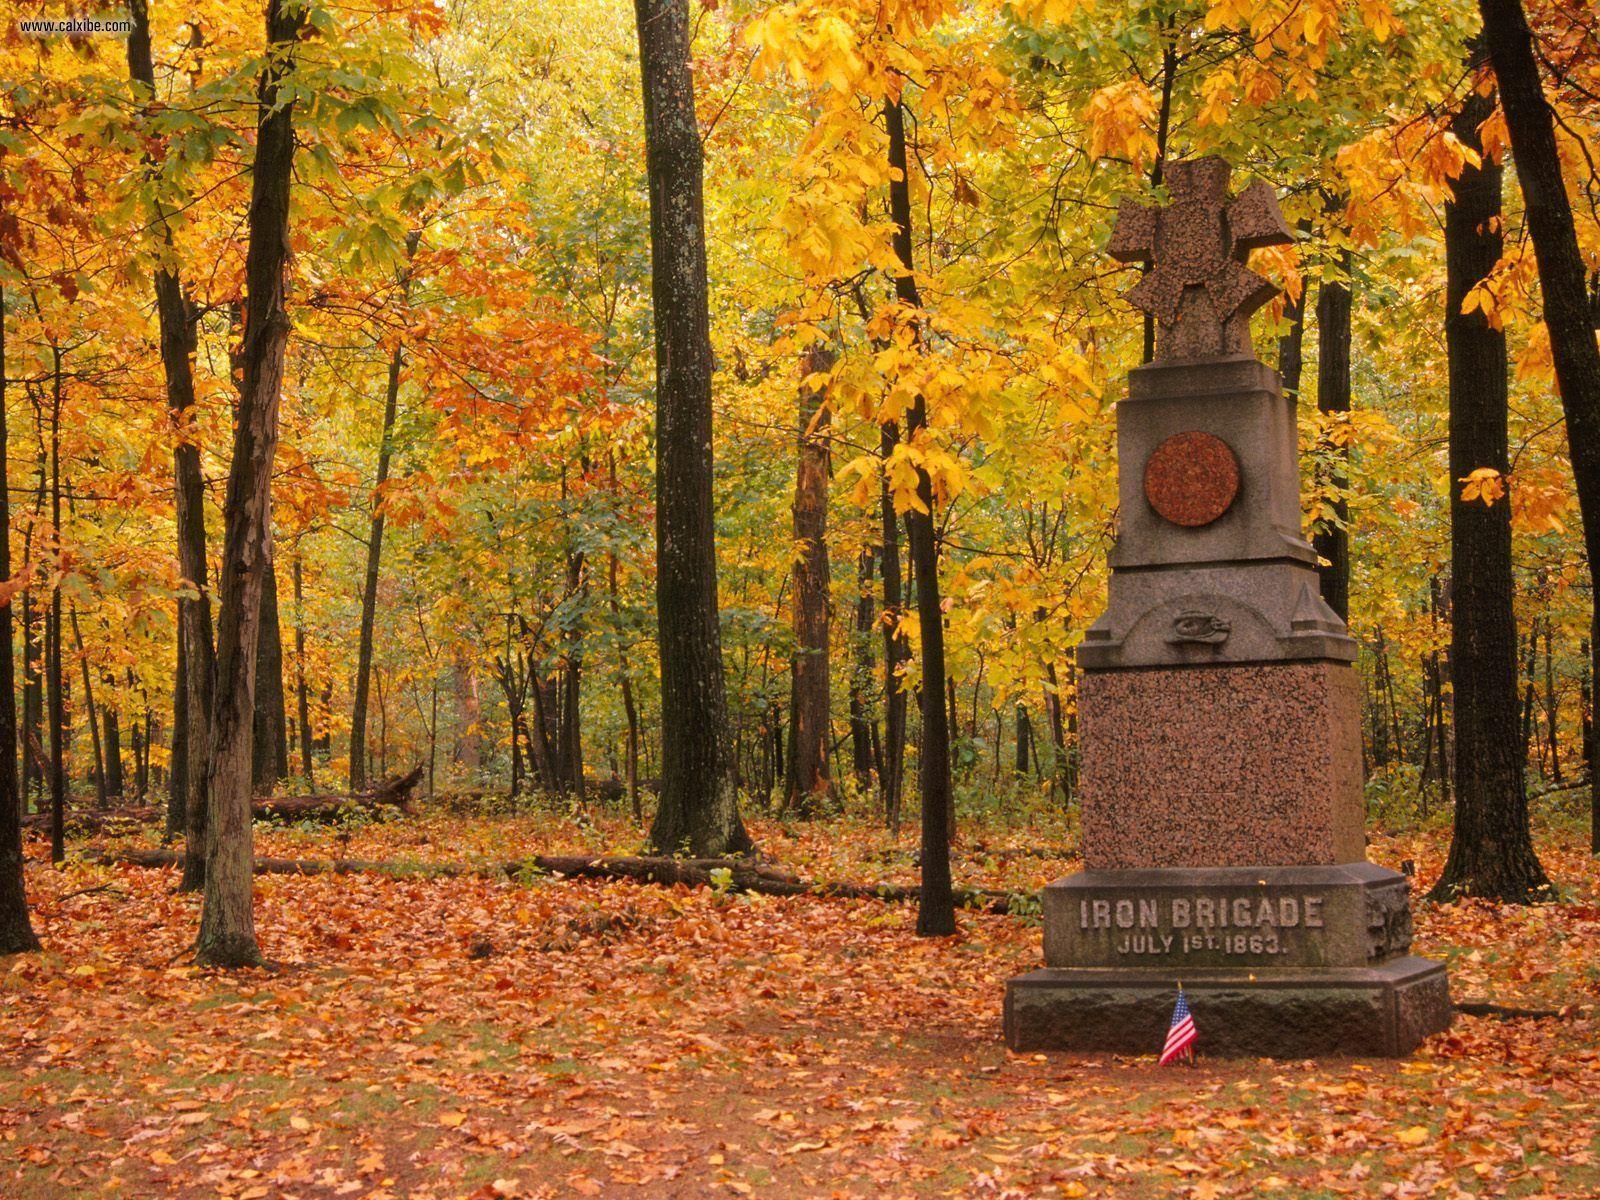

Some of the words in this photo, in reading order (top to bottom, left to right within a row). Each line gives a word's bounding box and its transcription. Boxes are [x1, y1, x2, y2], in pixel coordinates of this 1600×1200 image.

[1080, 898, 1159, 930] IRON
[1172, 896, 1325, 929] BRIGADE
[1117, 934, 1174, 955] JULY
[1225, 934, 1289, 955] 1863.
